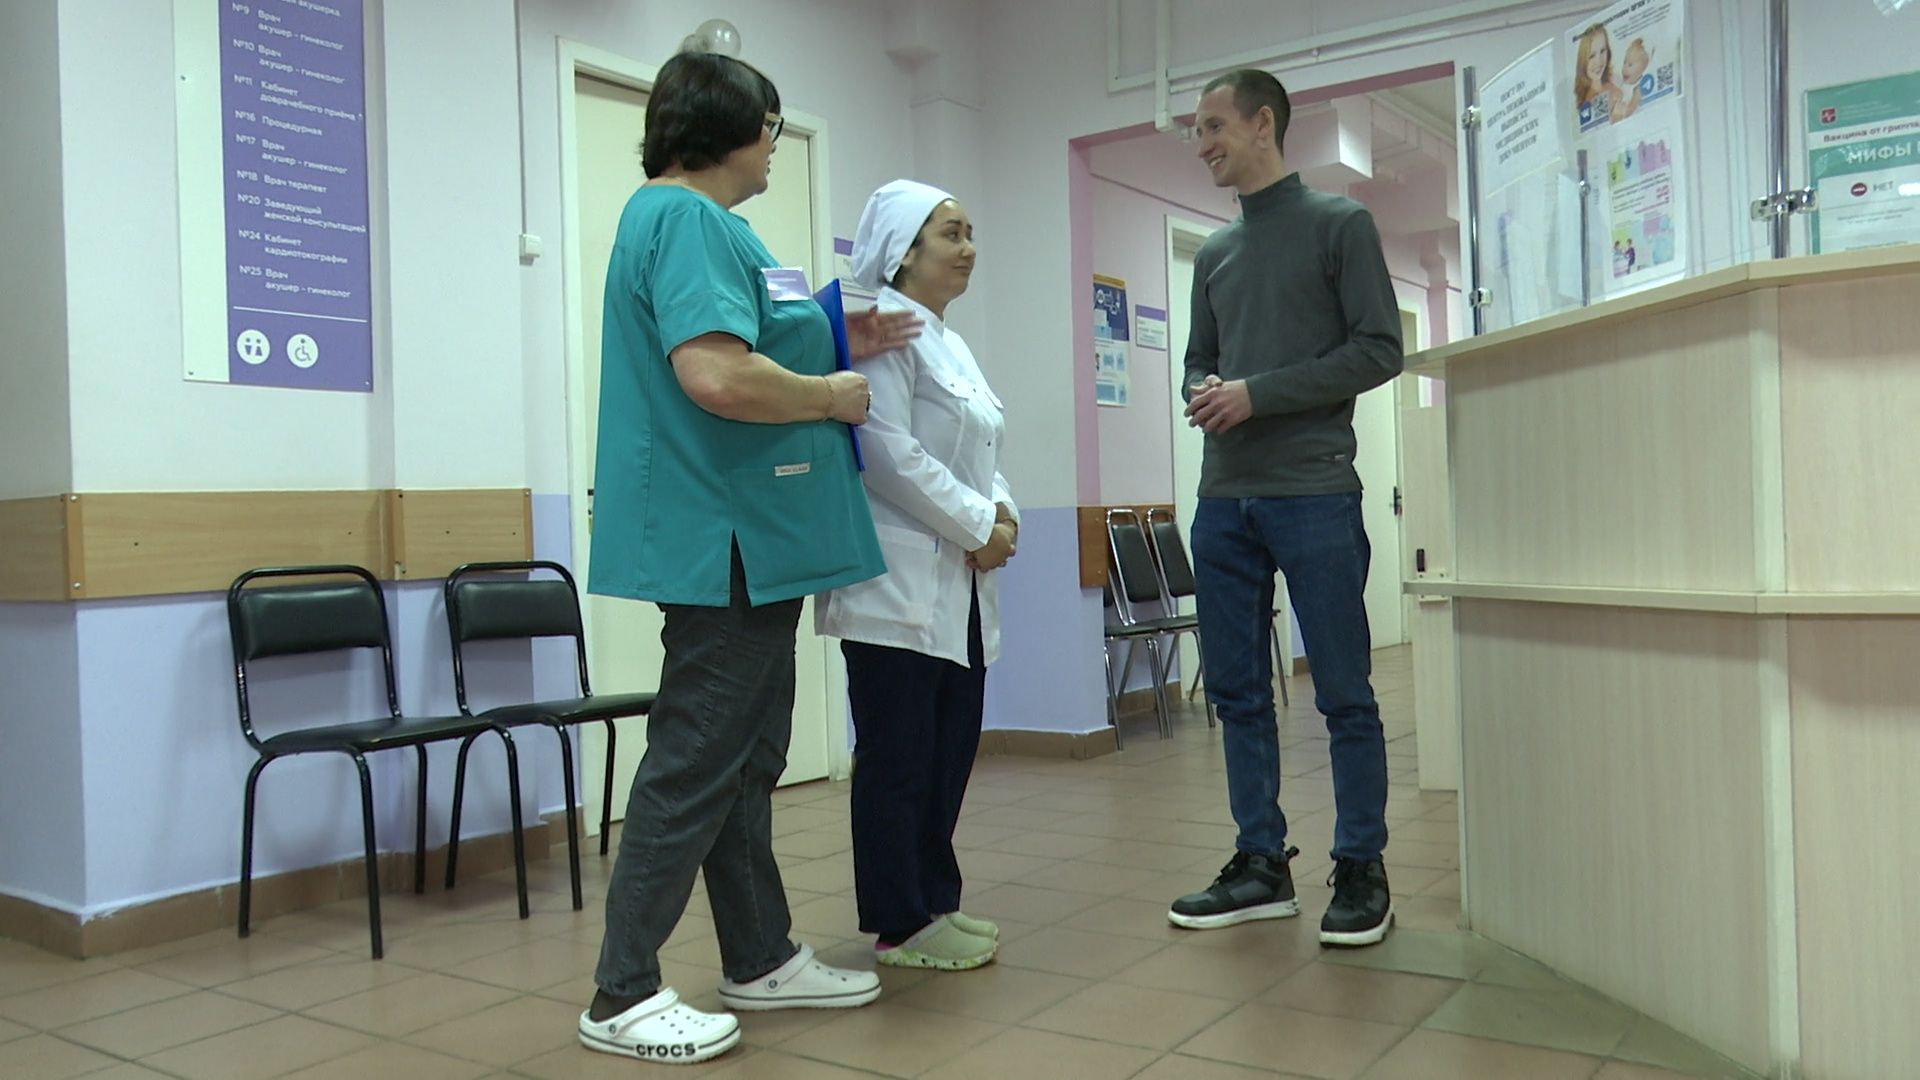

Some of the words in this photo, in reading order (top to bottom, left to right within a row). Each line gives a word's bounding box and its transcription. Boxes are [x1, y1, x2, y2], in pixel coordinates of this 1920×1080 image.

[232, 2, 249, 14] №9
[258, 10, 281, 23] Врач
[258, 23, 293, 38] акушер
[300, 34, 344, 50] гинеколог
[233, 39, 255, 51] №10
[258, 44, 281, 57] Врач
[259, 58, 293, 73] акушер
[301, 68, 345, 84] гинеколог
[234, 74, 253, 86] №11
[261, 80, 298, 96] Кабинет
[260, 93, 323, 113] доврачебного
[324, 107, 356, 121] приёма
[235, 110, 256, 122] №16
[262, 115, 322, 135] Процедурная
[236, 133, 256, 145] №17
[262, 138, 285, 151] Врач
[1824, 127, 1868, 143] Вакцина
[1869, 127, 1881, 136] от
[262, 152, 296, 166] акушер
[304, 160, 348, 174] гинеколог
[1848, 141, 1912, 164] МИФЫ
[236, 169, 258, 181] №18
[264, 174, 287, 186] Врач
[288, 179, 327, 193] терапевт
[1873, 181, 1894, 192] НЕТ
[238, 193, 261, 205] №20
[264, 198, 322, 215] Заведующий
[264, 211, 302, 224] женской
[303, 217, 366, 233] консультацией
[238, 229, 261, 240] №24
[264, 233, 302, 246] Кабинет
[264, 247, 348, 264] кардиотокографии
[239, 265, 262, 276] №25
[265, 268, 288, 280] Врач
[265, 282, 300, 293] акушер
[307, 286, 351, 298] гинеколог
[636, 1043, 696, 1057] crocs
